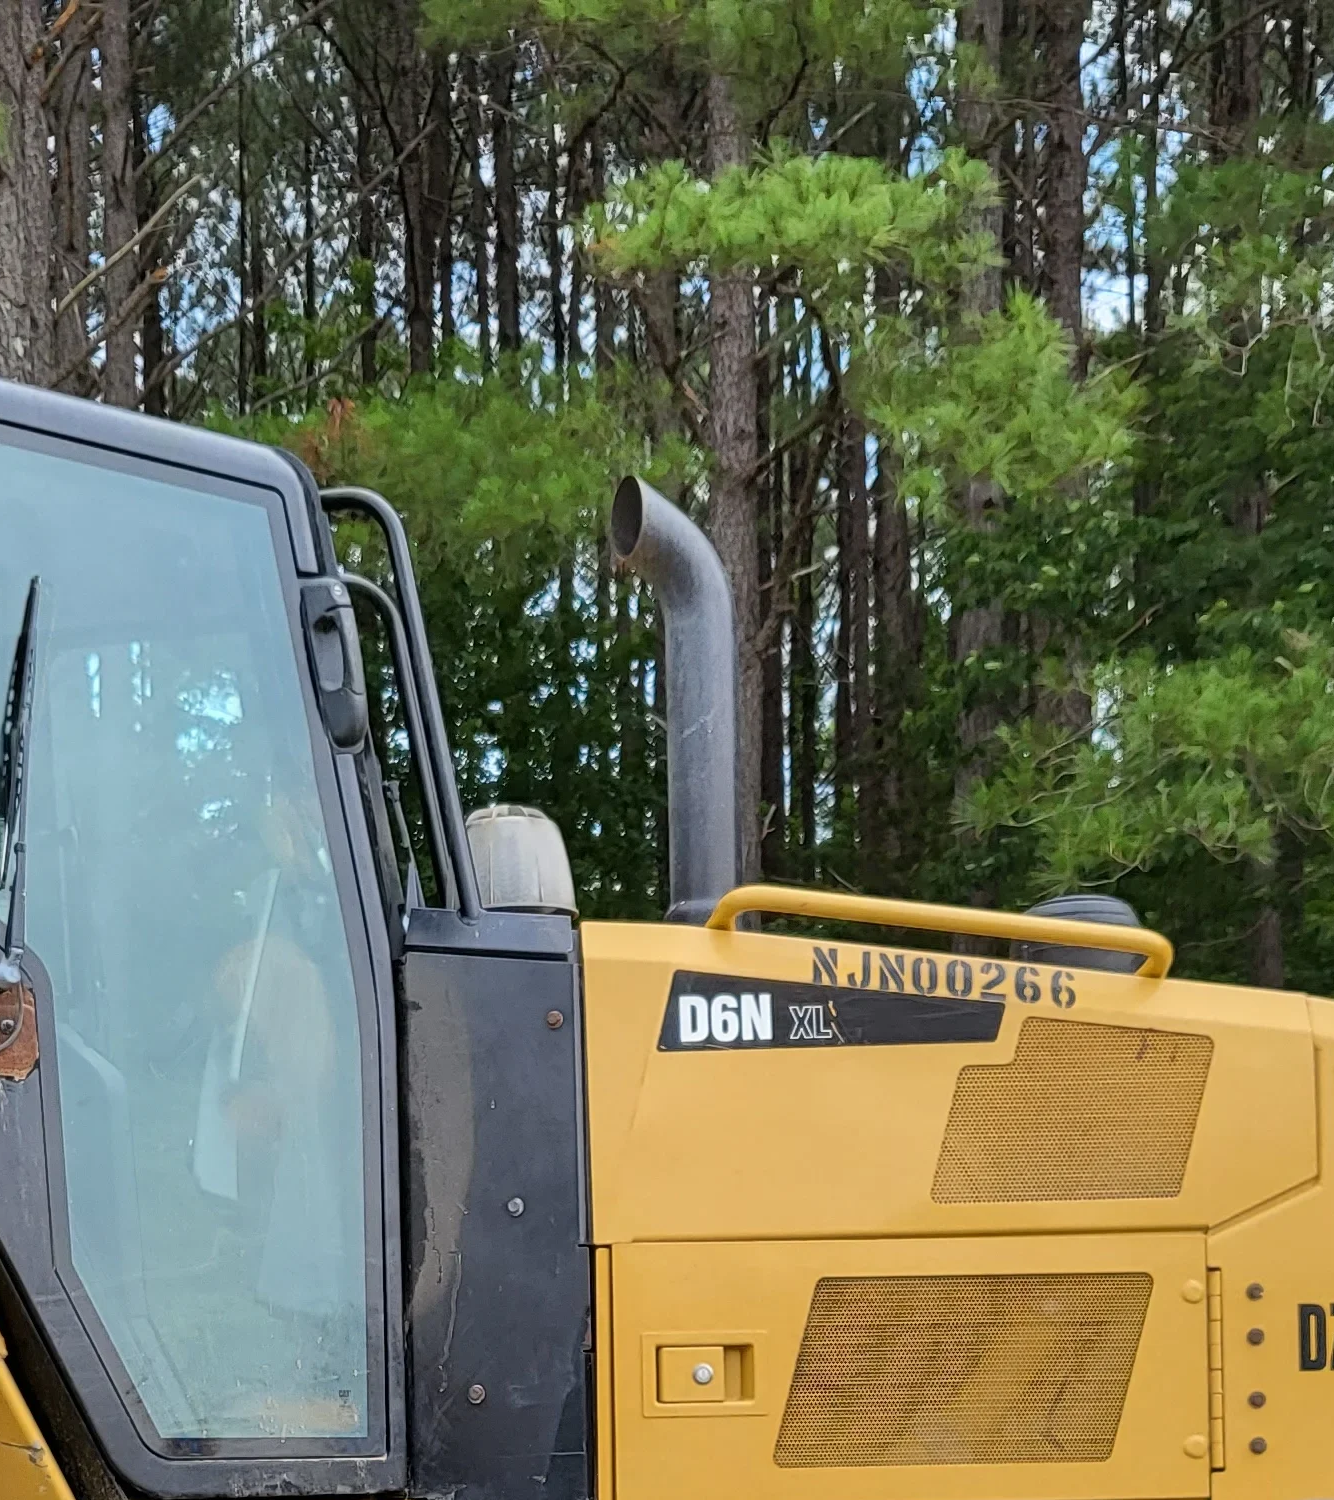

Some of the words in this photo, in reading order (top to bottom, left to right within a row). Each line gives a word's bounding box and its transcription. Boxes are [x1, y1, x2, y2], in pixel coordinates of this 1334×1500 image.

[812, 946, 1077, 1009] NJN00266
[679, 994, 773, 1044] D6N
[789, 1005, 833, 1040] XL
